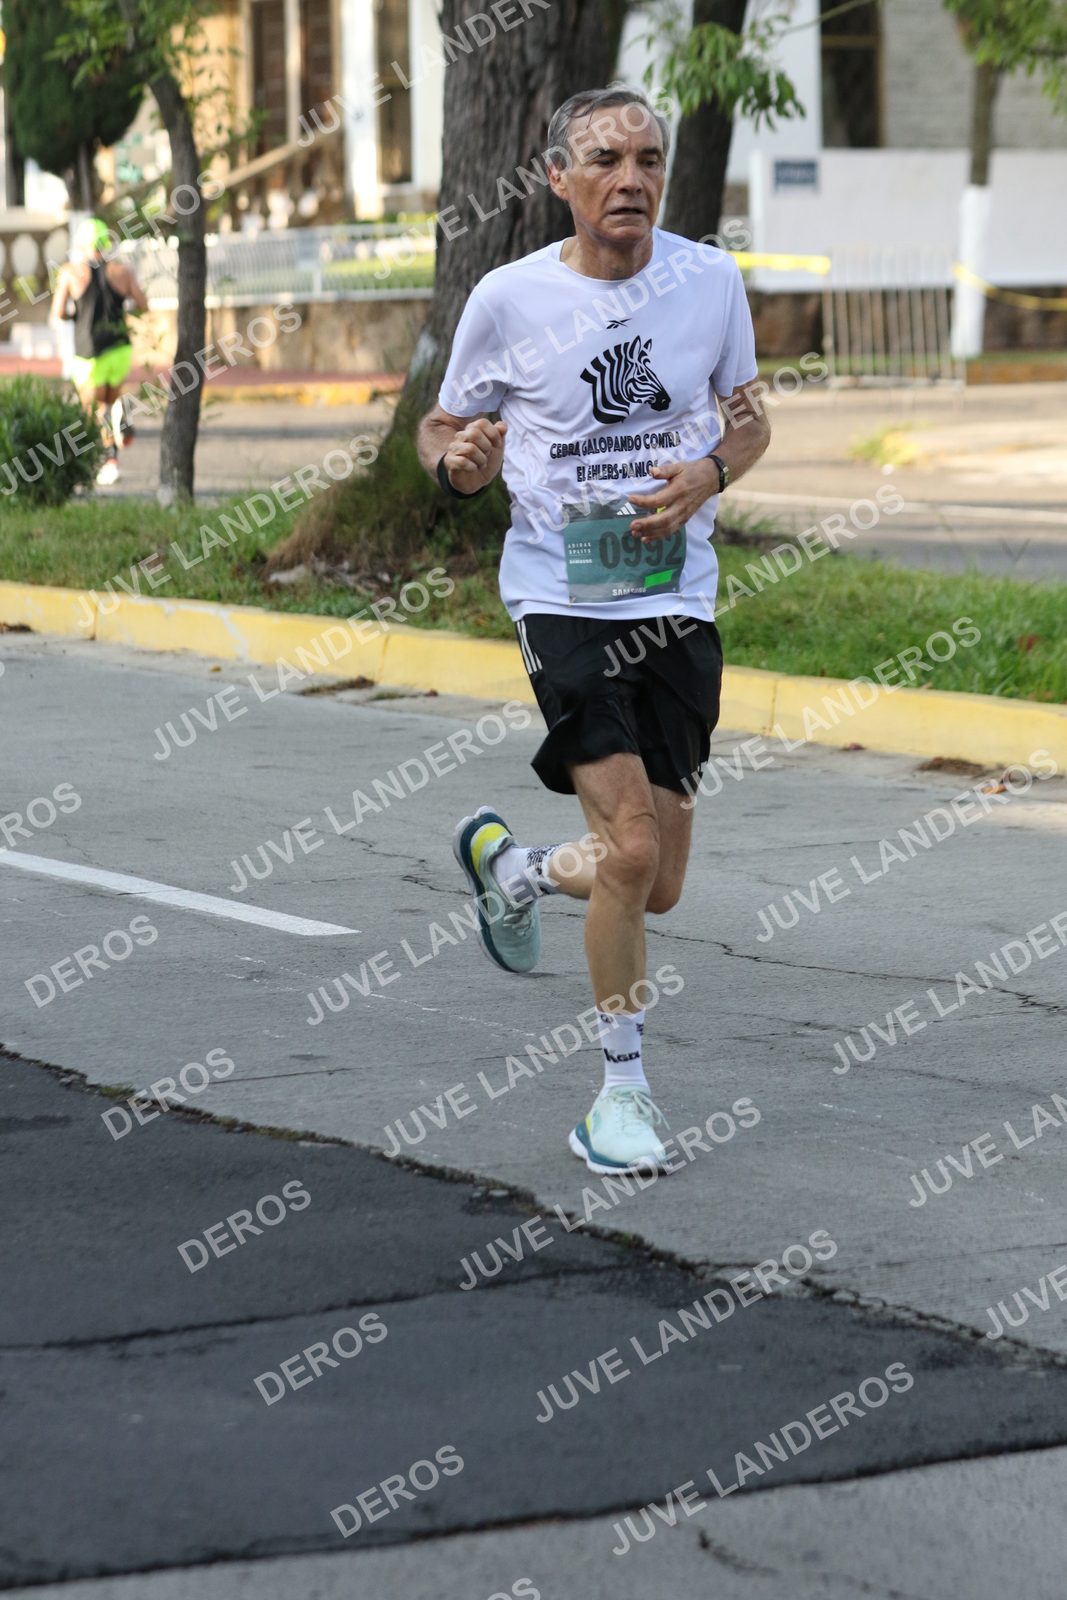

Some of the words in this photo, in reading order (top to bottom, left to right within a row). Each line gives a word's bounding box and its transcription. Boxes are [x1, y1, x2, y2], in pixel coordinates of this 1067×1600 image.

[549, 441, 580, 459] CEBRA
[581, 434, 641, 456] GALOPANDO
[643, 431, 681, 449] CONTRA
[599, 530, 682, 569] 0992
